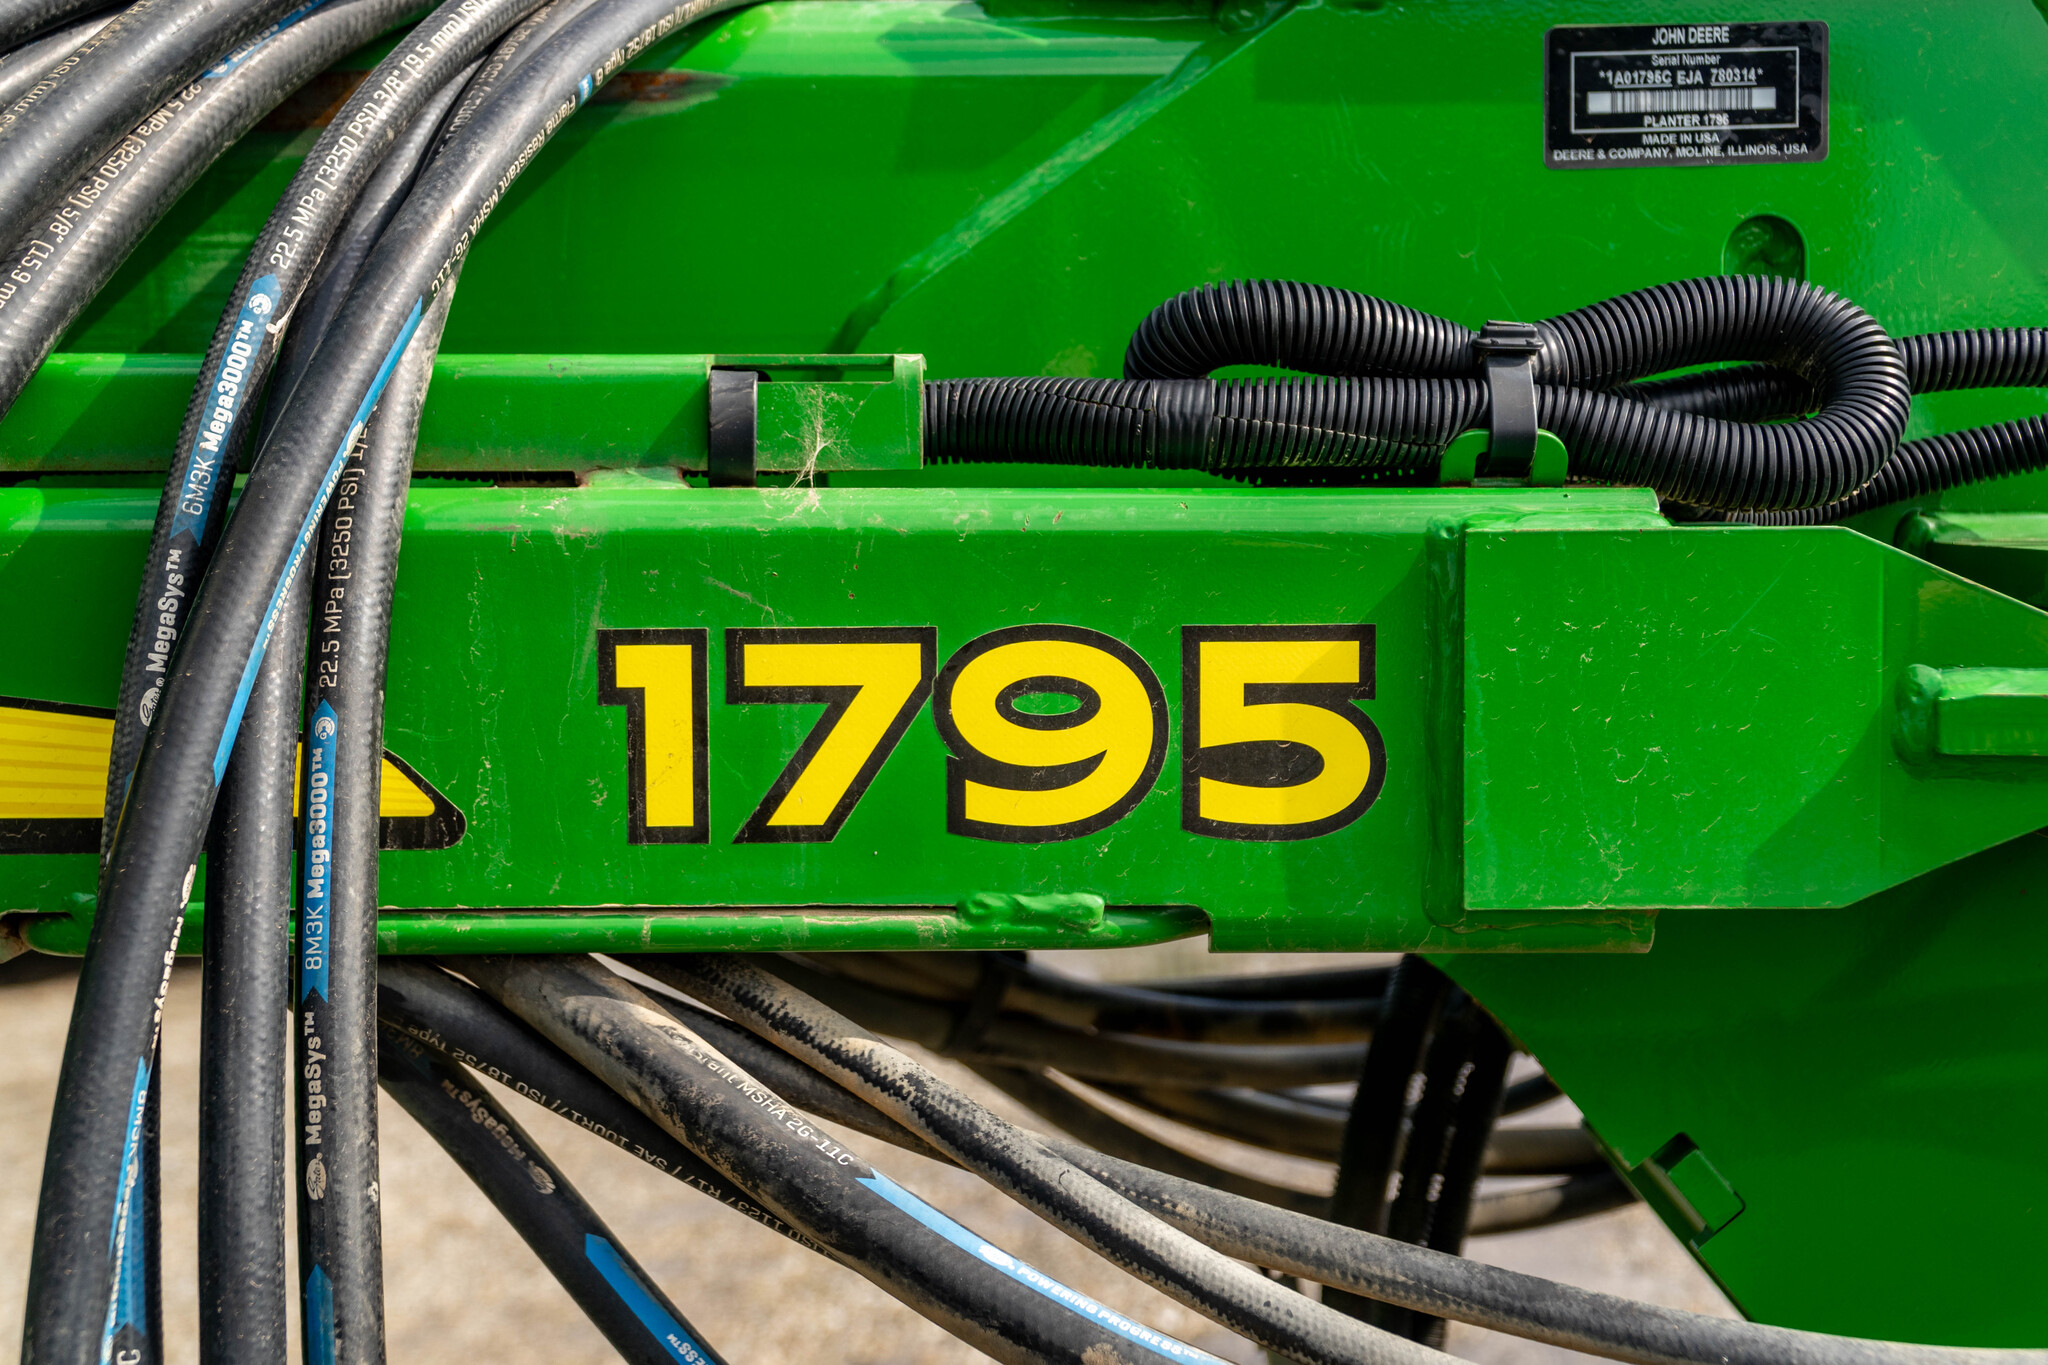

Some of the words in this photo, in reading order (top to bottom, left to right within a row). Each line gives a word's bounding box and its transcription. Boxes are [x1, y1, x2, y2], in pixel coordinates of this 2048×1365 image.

[1652, 28, 1686, 45] JOHN
[1689, 26, 1730, 44] DEERE
[1651, 55, 1681, 67] Serial
[1681, 53, 1721, 66] Number
[1676, 71, 1704, 86] EJA
[136, 107, 175, 137] MPa
[545, 94, 577, 136] Flame
[1644, 114, 1701, 127] PLANTER
[269, 226, 304, 270] 22.5
[292, 188, 327, 225] MPa
[314, 135, 358, 190] [3250
[402, 42, 436, 78] [9.5
[497, 129, 546, 194] Resistant
[1553, 149, 1595, 162] DEERE
[1596, 149, 1607, 160] &
[1608, 147, 1673, 161] COMPANY,
[1675, 146, 1726, 159] MOLINE,
[1727, 144, 1782, 158] ILLINOIS,
[1783, 143, 1809, 156] USA
[1642, 133, 1678, 146] MADE
[1681, 133, 1693, 145] IN
[1695, 132, 1720, 145] USA
[468, 194, 500, 236] MSHA
[10, 239, 55, 284] [15.9
[182, 455, 216, 517] 6M3K
[303, 458, 345, 547] POWERING
[327, 517, 354, 581] [3250
[145, 548, 185, 674] MegaSys™
[322, 587, 345, 634] MPa
[318, 639, 341, 688] 22.5
[598, 624, 1387, 845] 1795
[305, 904, 324, 971] 8M3K
[407, 1023, 448, 1053] Type
[304, 1011, 327, 1146] MegaSys™
[451, 1046, 514, 1085] 18752
[514, 1081, 548, 1106] ISO
[736, 1080, 788, 1121] MSHA
[785, 1117, 856, 1168] 2G-11C
[634, 1143, 669, 1172] SAE
[1016, 1266, 1098, 1315] POWERING
